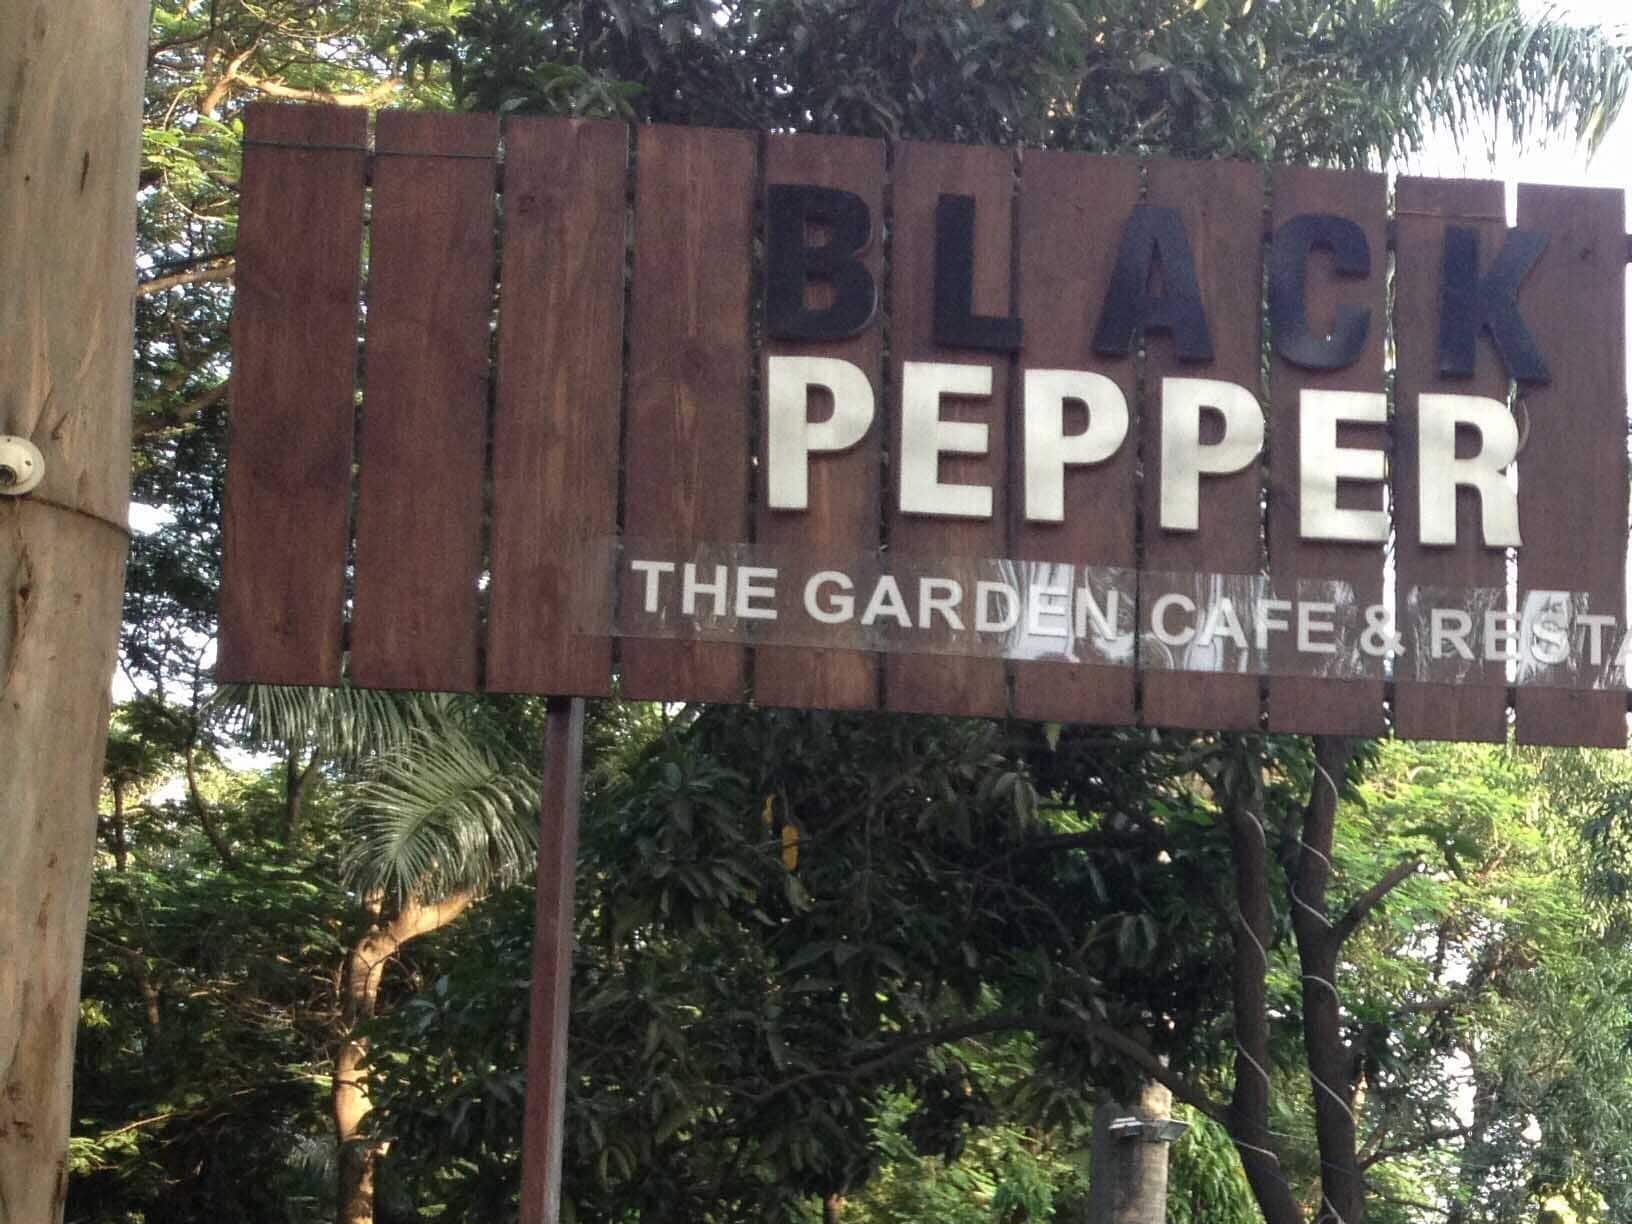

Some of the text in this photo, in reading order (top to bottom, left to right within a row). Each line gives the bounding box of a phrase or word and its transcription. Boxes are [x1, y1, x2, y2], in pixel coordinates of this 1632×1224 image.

[765, 184, 1551, 385] BLACK
[768, 356, 1523, 549] PEPPER
[632, 560, 779, 620] THE
[804, 570, 1118, 641] GARDEN
[1151, 592, 1337, 655] CAFE
[1359, 605, 1404, 658] &
